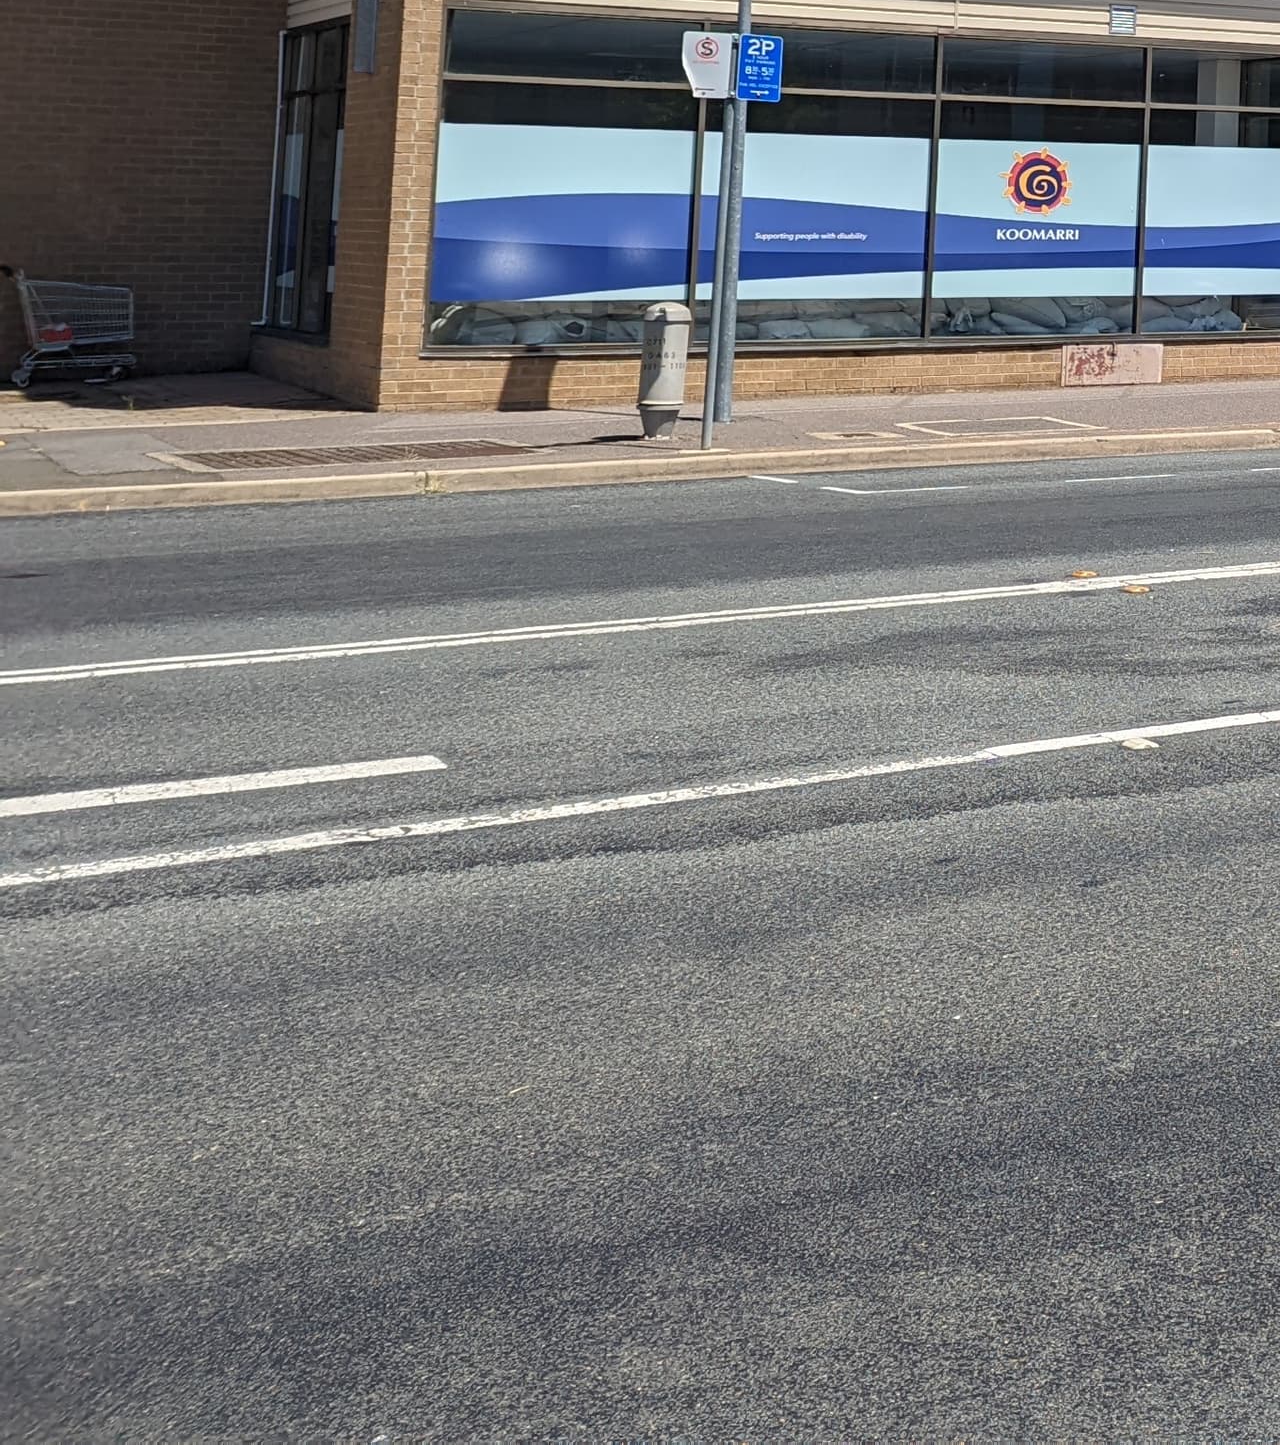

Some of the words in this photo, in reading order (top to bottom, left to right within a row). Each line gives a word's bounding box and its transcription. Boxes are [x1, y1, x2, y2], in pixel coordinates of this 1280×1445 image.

[747, 38, 775, 56] 2P
[754, 232, 794, 242] Supporting
[794, 233, 820, 242] people
[836, 233, 868, 242] disability
[996, 228, 1080, 241] KOOMARRI
